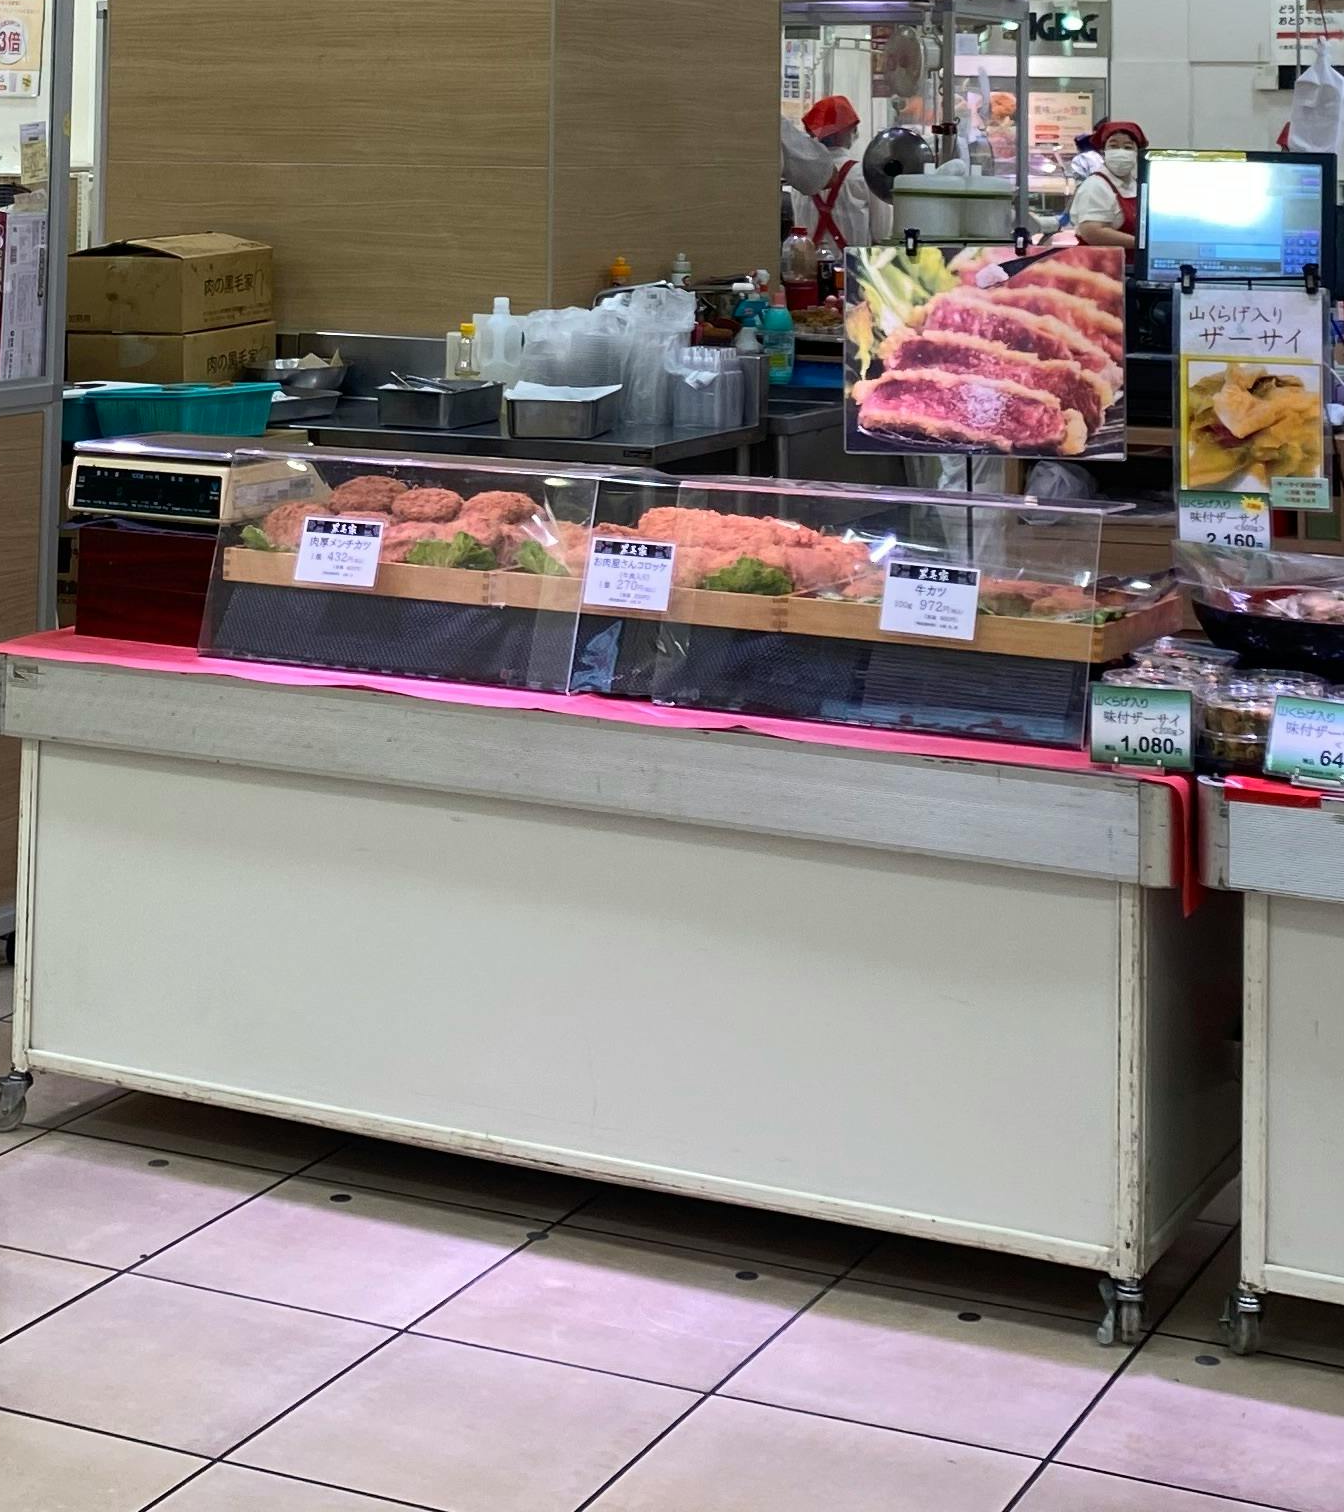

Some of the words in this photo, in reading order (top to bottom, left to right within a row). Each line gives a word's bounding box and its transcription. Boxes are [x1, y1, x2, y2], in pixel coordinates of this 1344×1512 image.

[203, 273, 254, 297] 肉の黒毛家
[1189, 304, 1283, 325] 山くらげ入り
[1199, 326, 1302, 354] ザーサイ
[1181, 497, 1231, 510] 山くらげ入り
[1190, 511, 1260, 527] 味付ザーサイ
[310, 537, 372, 551] 肉厚メンチカツ
[594, 557, 667, 572] お肉屋さんコロッケ
[915, 584, 947, 597] 牛カツ
[1094, 695, 1149, 708] 山くらげ入り
[1104, 711, 1180, 728] 味付ザーサイ
[1277, 706, 1336, 723] 山くらげ入り
